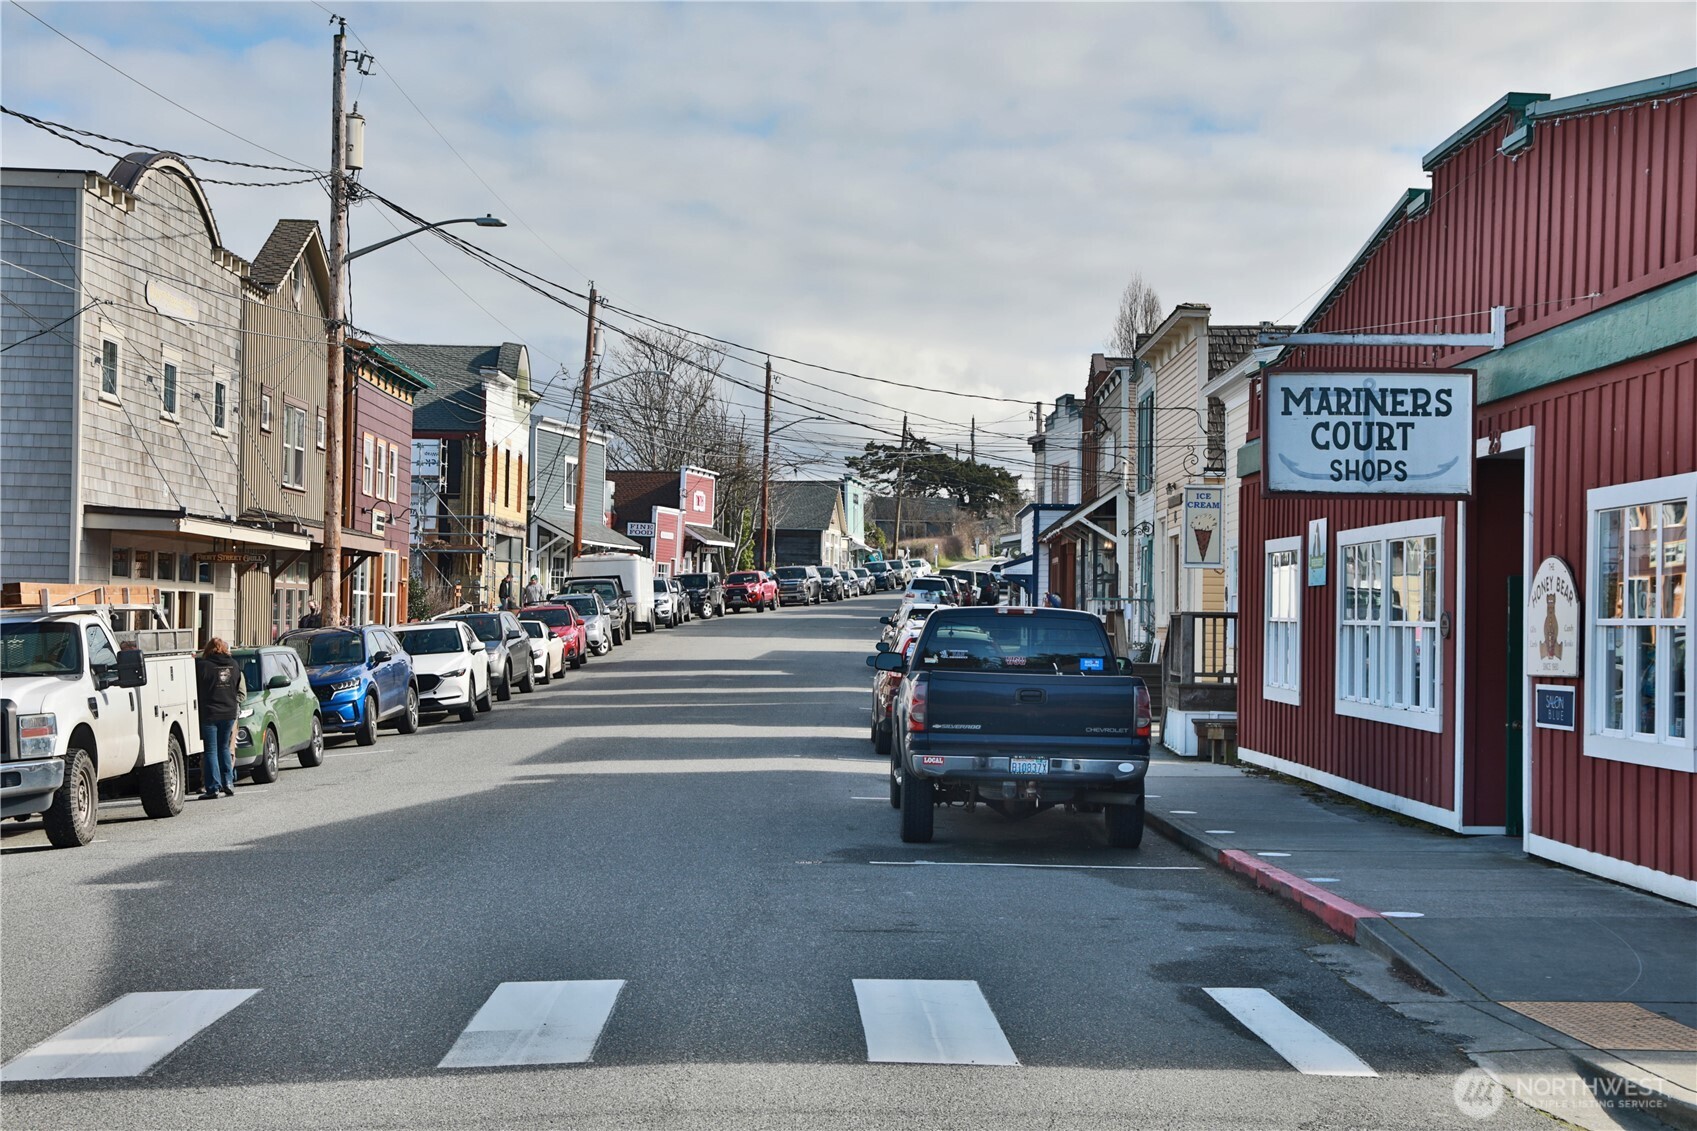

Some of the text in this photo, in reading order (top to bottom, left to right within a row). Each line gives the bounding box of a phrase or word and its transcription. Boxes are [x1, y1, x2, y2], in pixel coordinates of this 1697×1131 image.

[1280, 387, 1452, 417] MARINERS
[1311, 421, 1414, 451] COURT
[1329, 459, 1408, 482] SHOPS
[1187, 501, 1220, 509] CREAM
[1532, 576, 1574, 608] HONEY BEAR
[1546, 695, 1564, 709] SALON
[1549, 709, 1564, 721] BLUE
